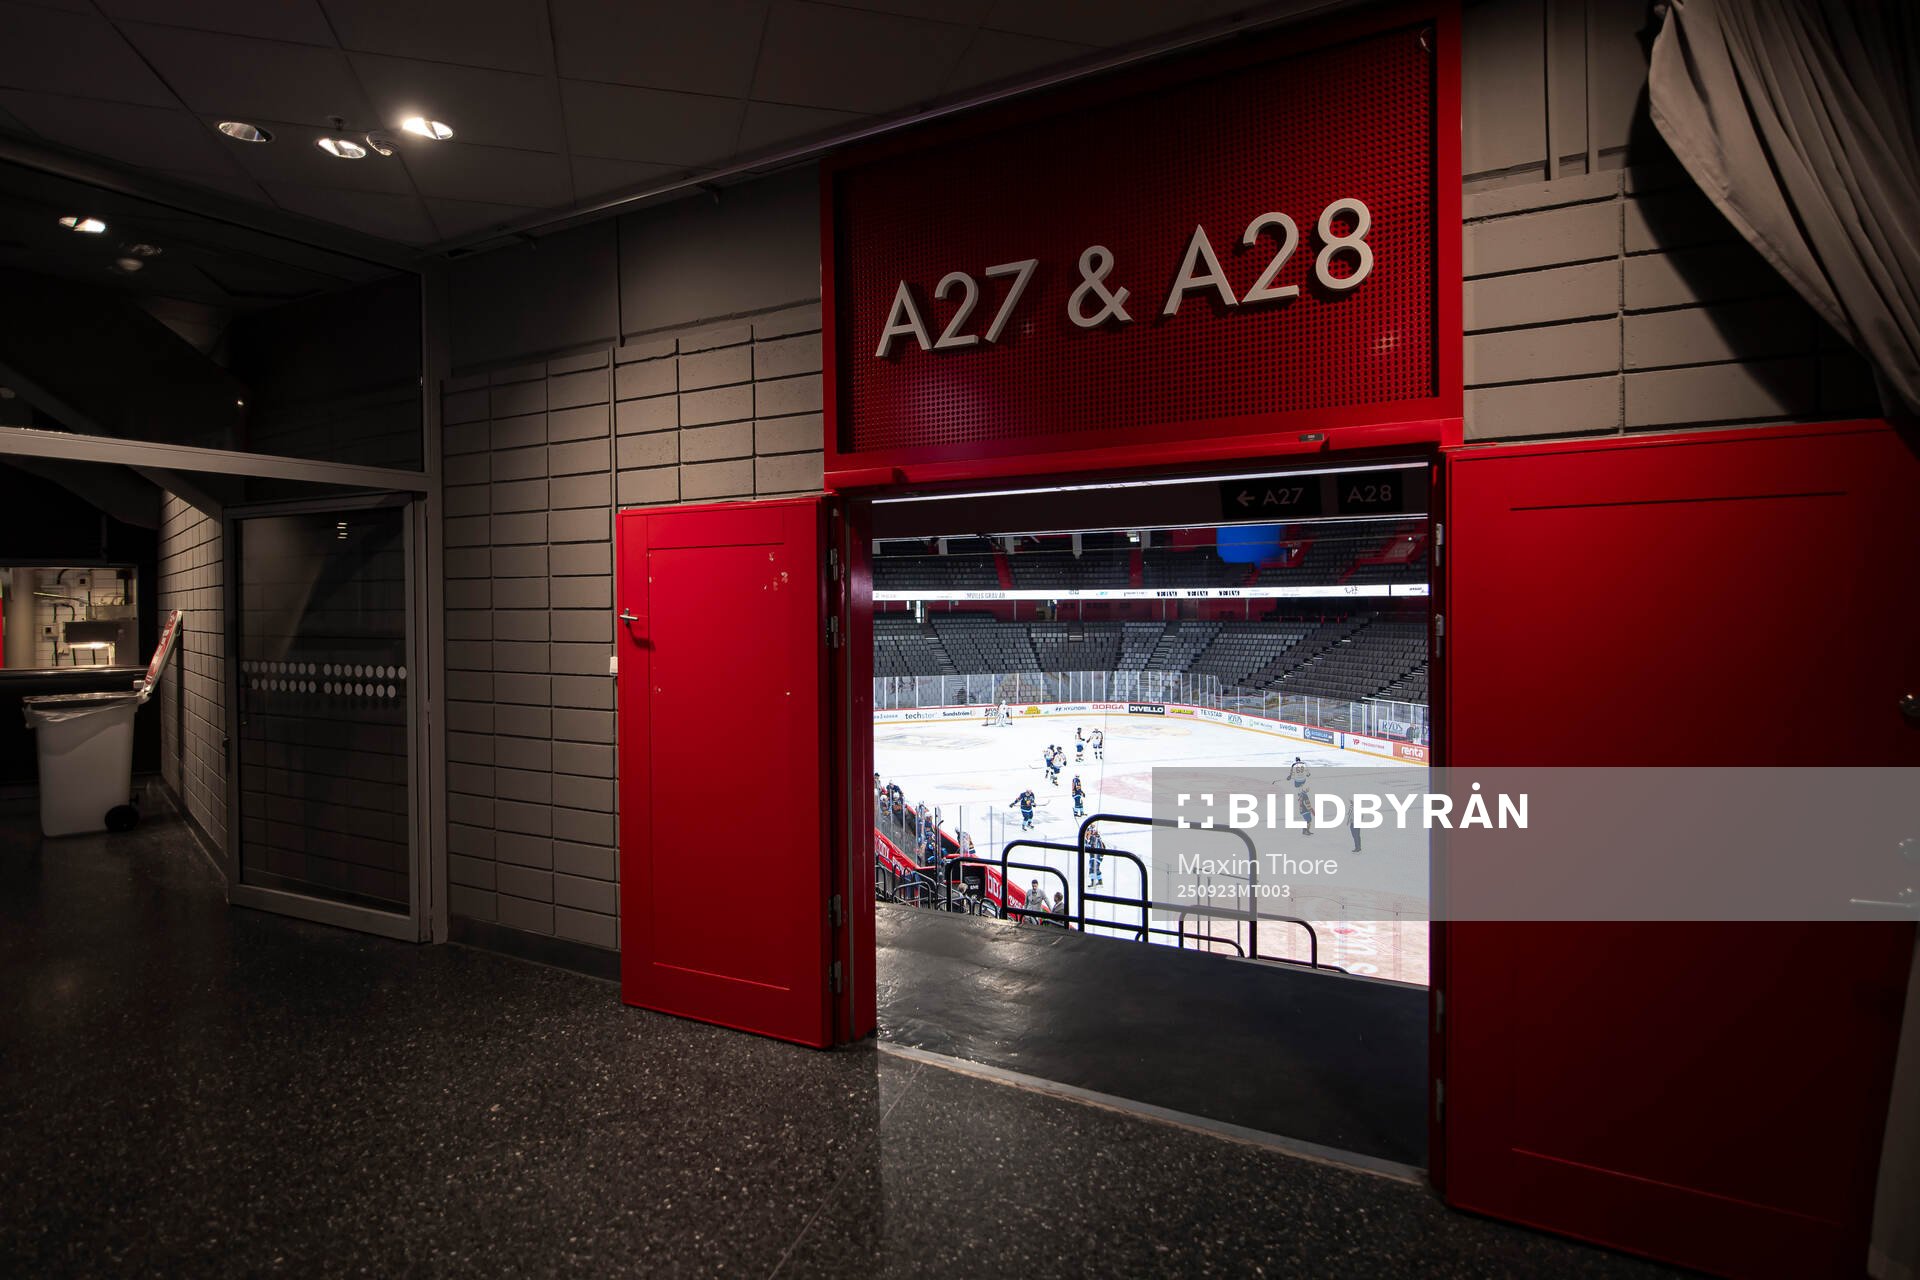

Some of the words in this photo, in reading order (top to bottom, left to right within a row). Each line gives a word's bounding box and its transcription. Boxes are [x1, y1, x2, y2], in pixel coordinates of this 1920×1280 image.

[876, 259, 1039, 357] A27
[1068, 245, 1133, 328] &
[1164, 198, 1374, 316] A28
[1263, 487, 1304, 505] A27
[1347, 485, 1392, 503] A28
[1401, 746, 1424, 758] renta
